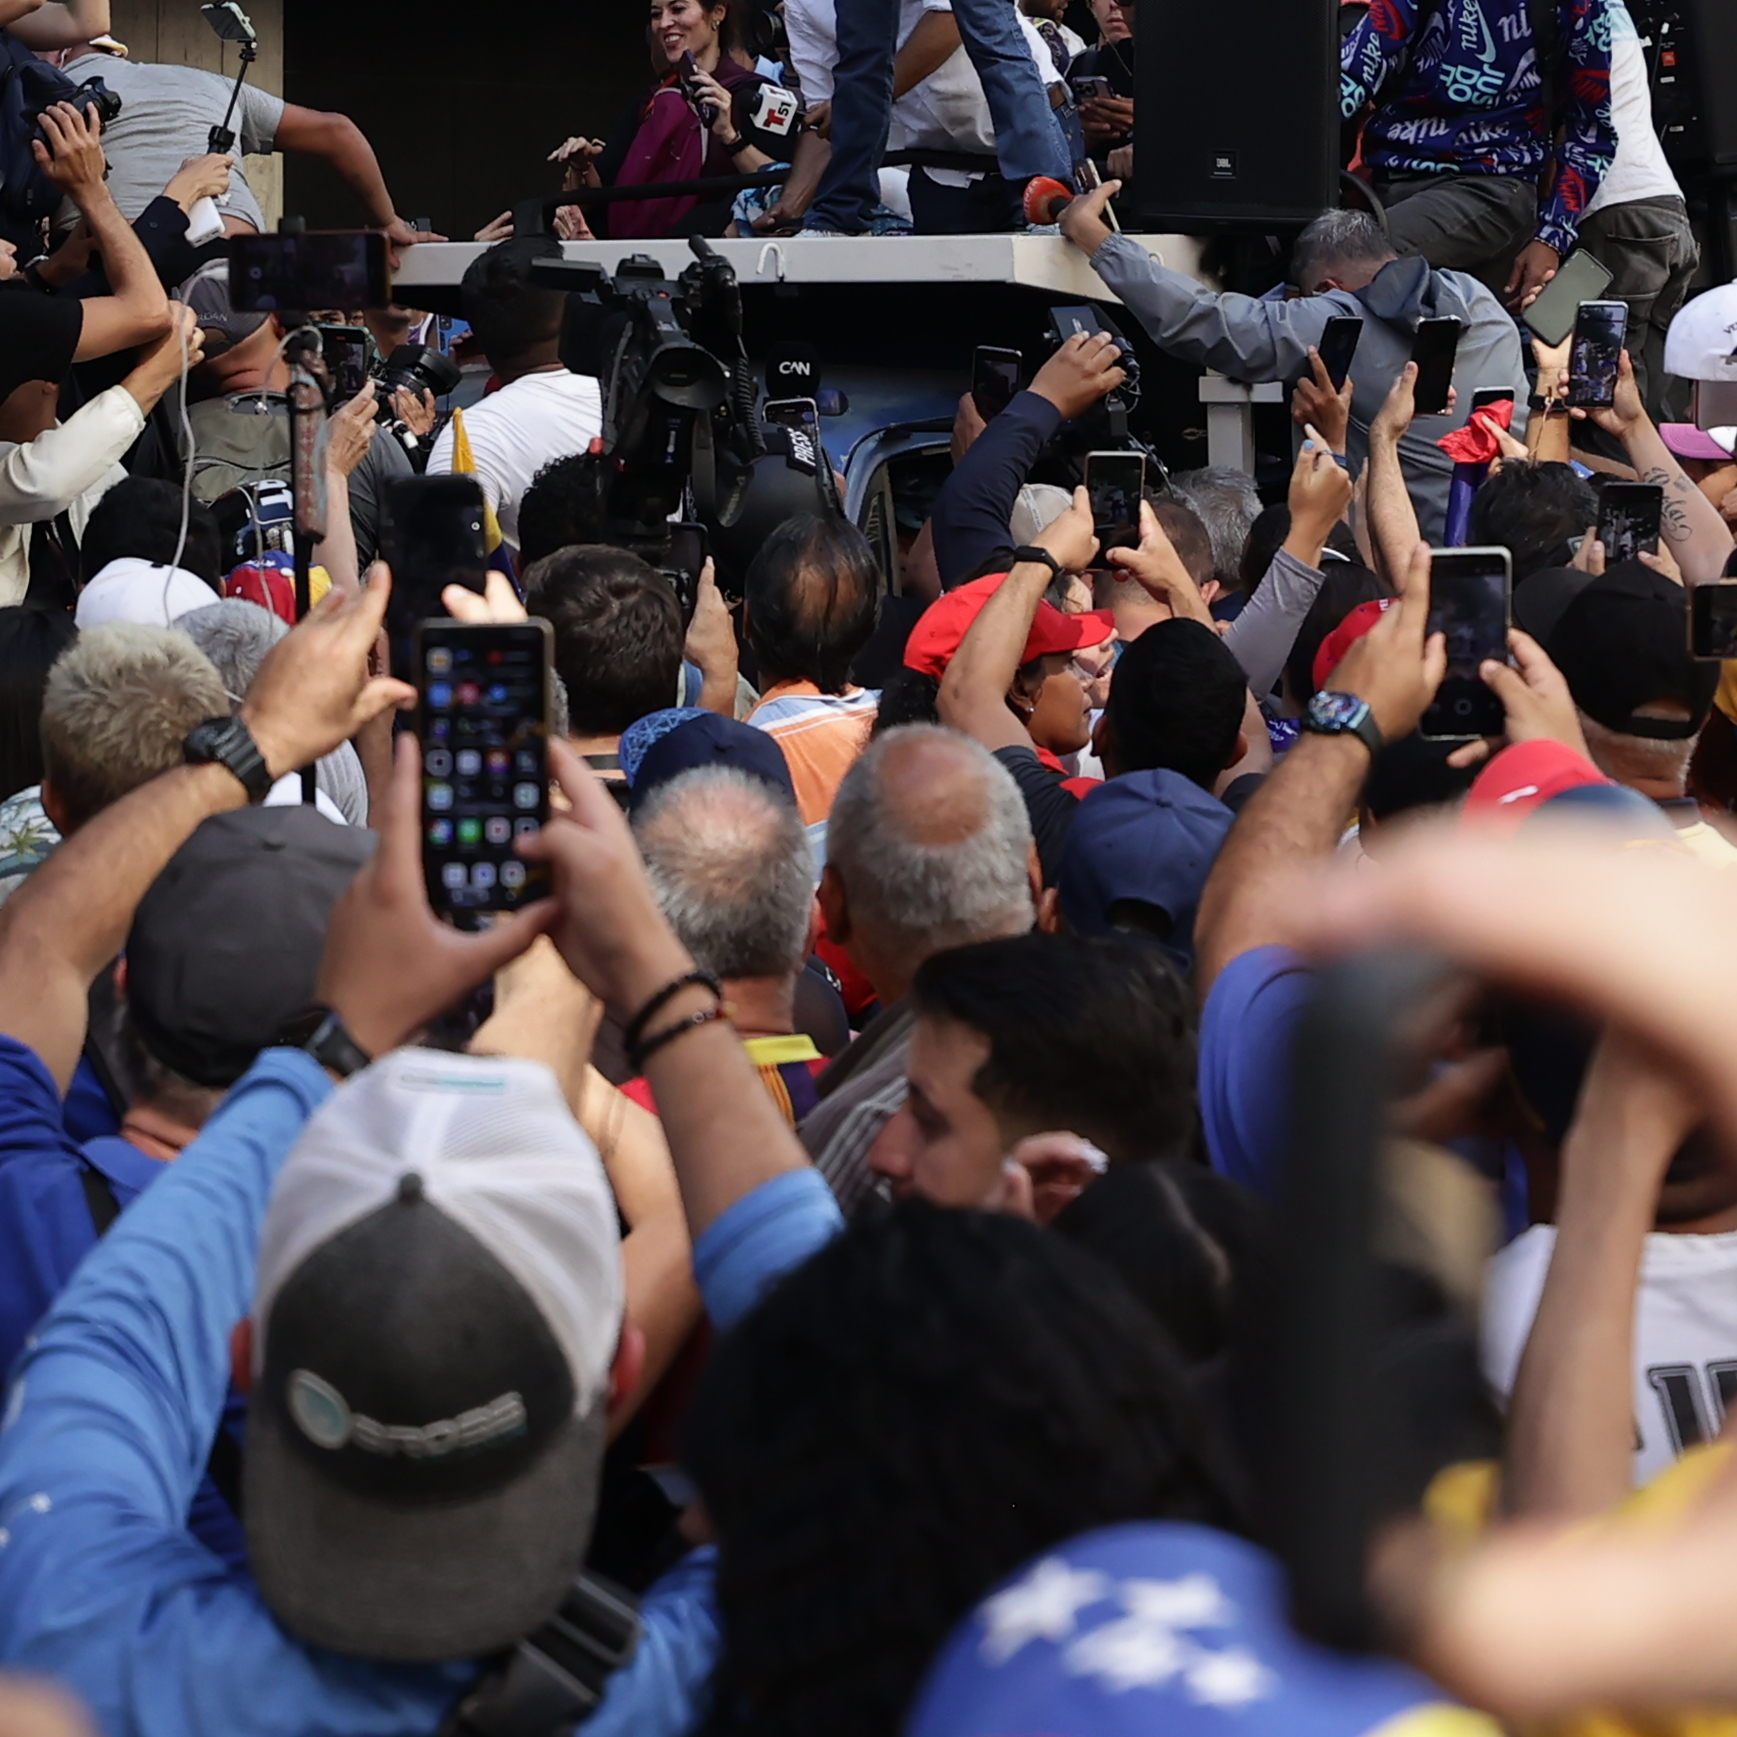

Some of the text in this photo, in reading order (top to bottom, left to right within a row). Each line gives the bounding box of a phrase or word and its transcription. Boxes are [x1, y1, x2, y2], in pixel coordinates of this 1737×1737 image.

[1360, 31, 1382, 83] nike
[1386, 117, 1451, 145] nike
[786, 427, 817, 467] PRESS
